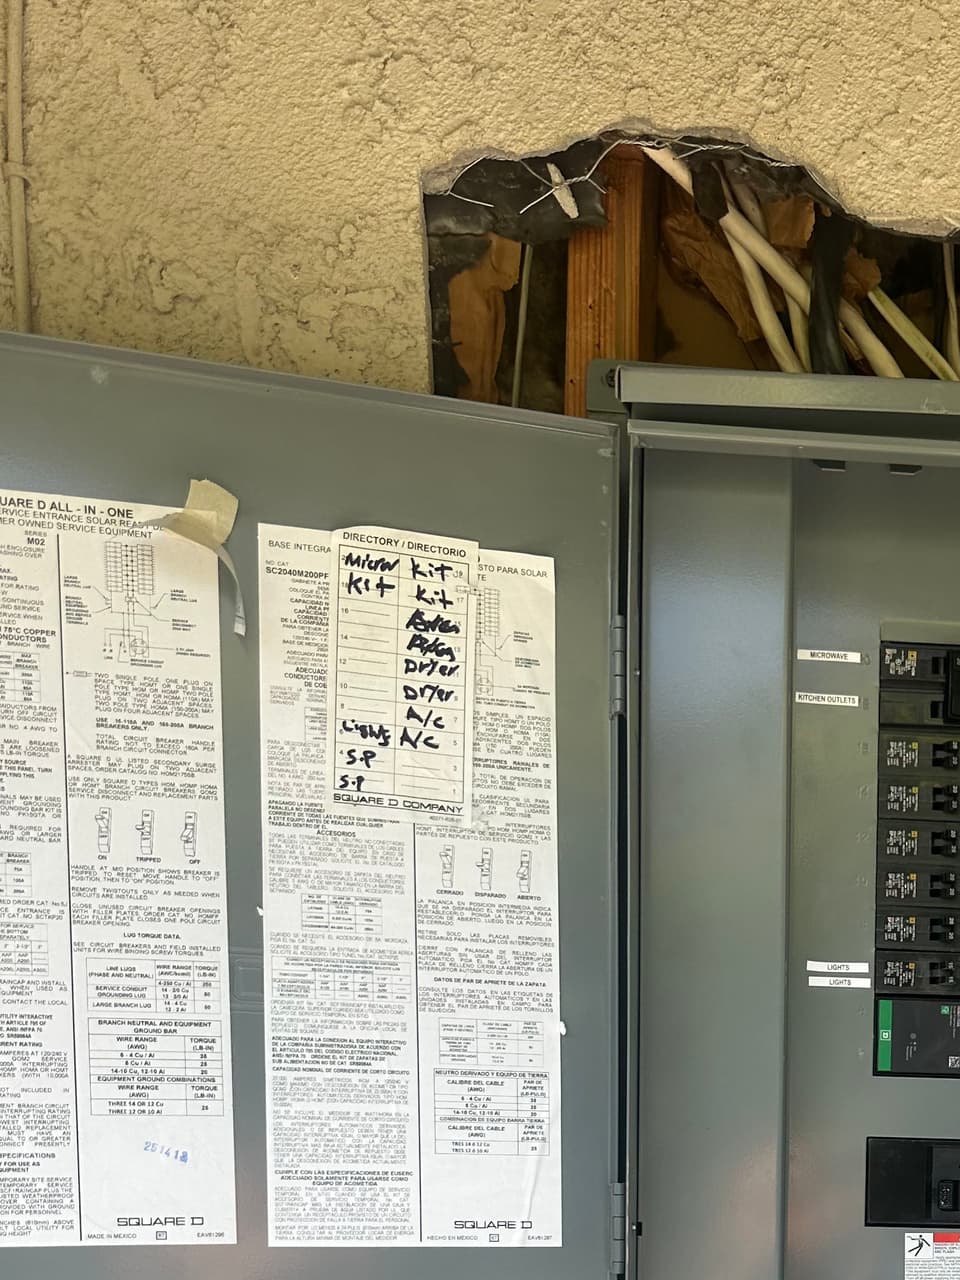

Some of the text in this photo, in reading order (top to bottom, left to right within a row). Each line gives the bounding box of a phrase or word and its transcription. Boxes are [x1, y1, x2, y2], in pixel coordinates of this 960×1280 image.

[38, 501, 46, 510] D
[50, 502, 73, 513] ALL
[84, 505, 96, 515] IN
[107, 507, 134, 519] ONE
[33, 510, 83, 523] ENTRANCE
[86, 515, 117, 526] SOLAR
[18, 519, 54, 529] OWNED
[56, 522, 96, 534] SERVICE
[99, 526, 153, 539] EQUIPMENT
[27, 537, 45, 546] M02
[268, 539, 291, 550] BASE
[343, 531, 400, 548] DIRECTORY
[407, 541, 467, 558] DIRECTORIO
[497, 565, 519, 575] PARA
[520, 568, 548, 578] SOLAR
[23, 628, 56, 637] COPPER
[810, 651, 849, 660] MICROWAVE
[798, 694, 856, 704] KITCHEN OUTLETS
[406, 705, 445, 729] A/C
[400, 726, 440, 749] A/C
[333, 793, 463, 813] SQUARE D COMPANY
[316, 829, 357, 838] ACCESORIOS
[827, 963, 850, 971] LIGHTS
[829, 978, 852, 986] LIGHTS
[117, 1216, 204, 1227] SQUARE D
[454, 1220, 533, 1229] SQUARE D
